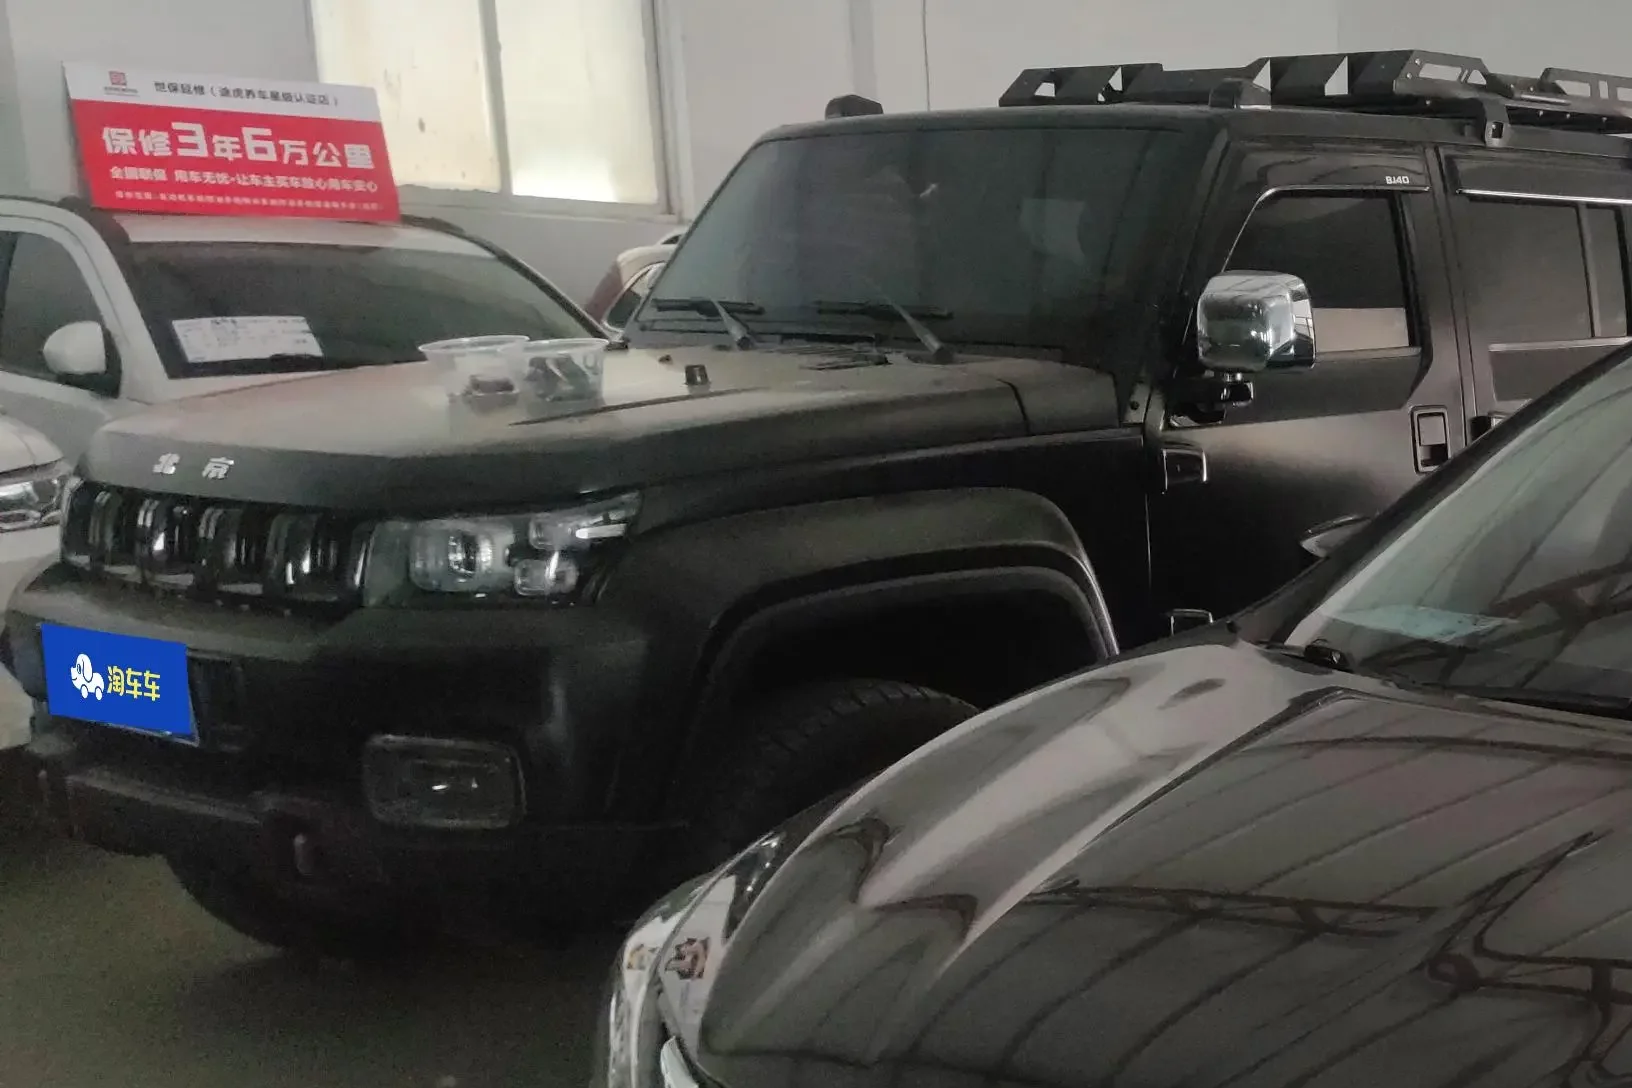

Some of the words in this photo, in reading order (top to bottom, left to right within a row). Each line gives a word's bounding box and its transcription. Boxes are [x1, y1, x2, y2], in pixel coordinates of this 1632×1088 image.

[102, 121, 375, 170] 保修3年6万公里
[153, 452, 235, 481] 北京
